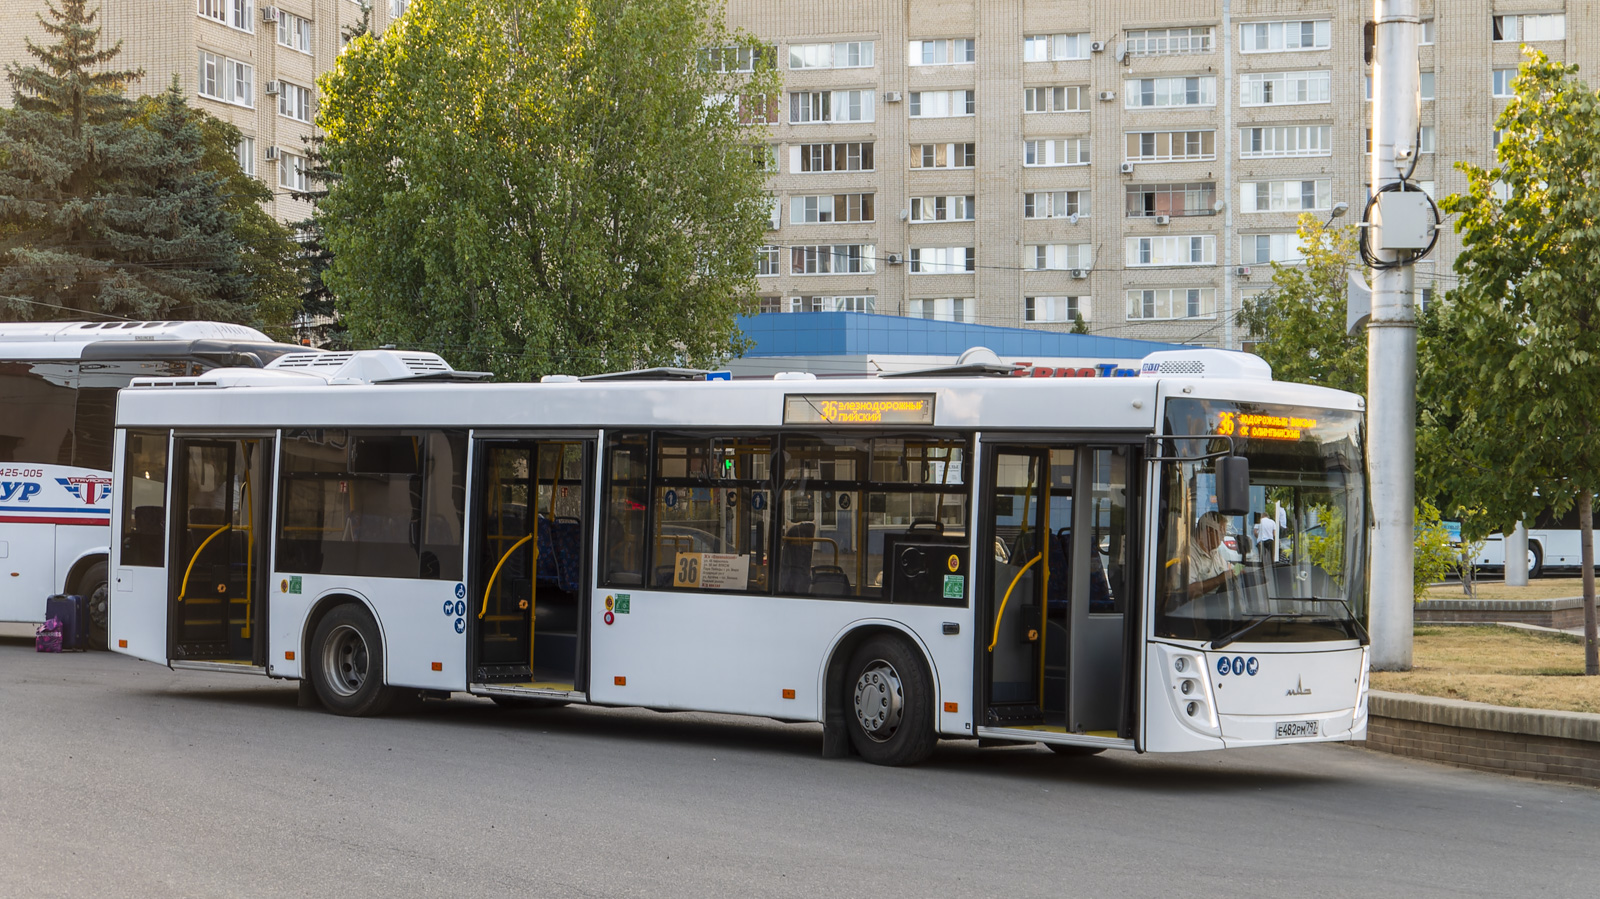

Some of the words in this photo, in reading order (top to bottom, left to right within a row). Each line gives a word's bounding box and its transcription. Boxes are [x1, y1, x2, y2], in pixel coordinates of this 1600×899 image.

[820, 400, 838, 420] 36
[1218, 411, 1235, 435] 36
[678, 557, 698, 583] 36
